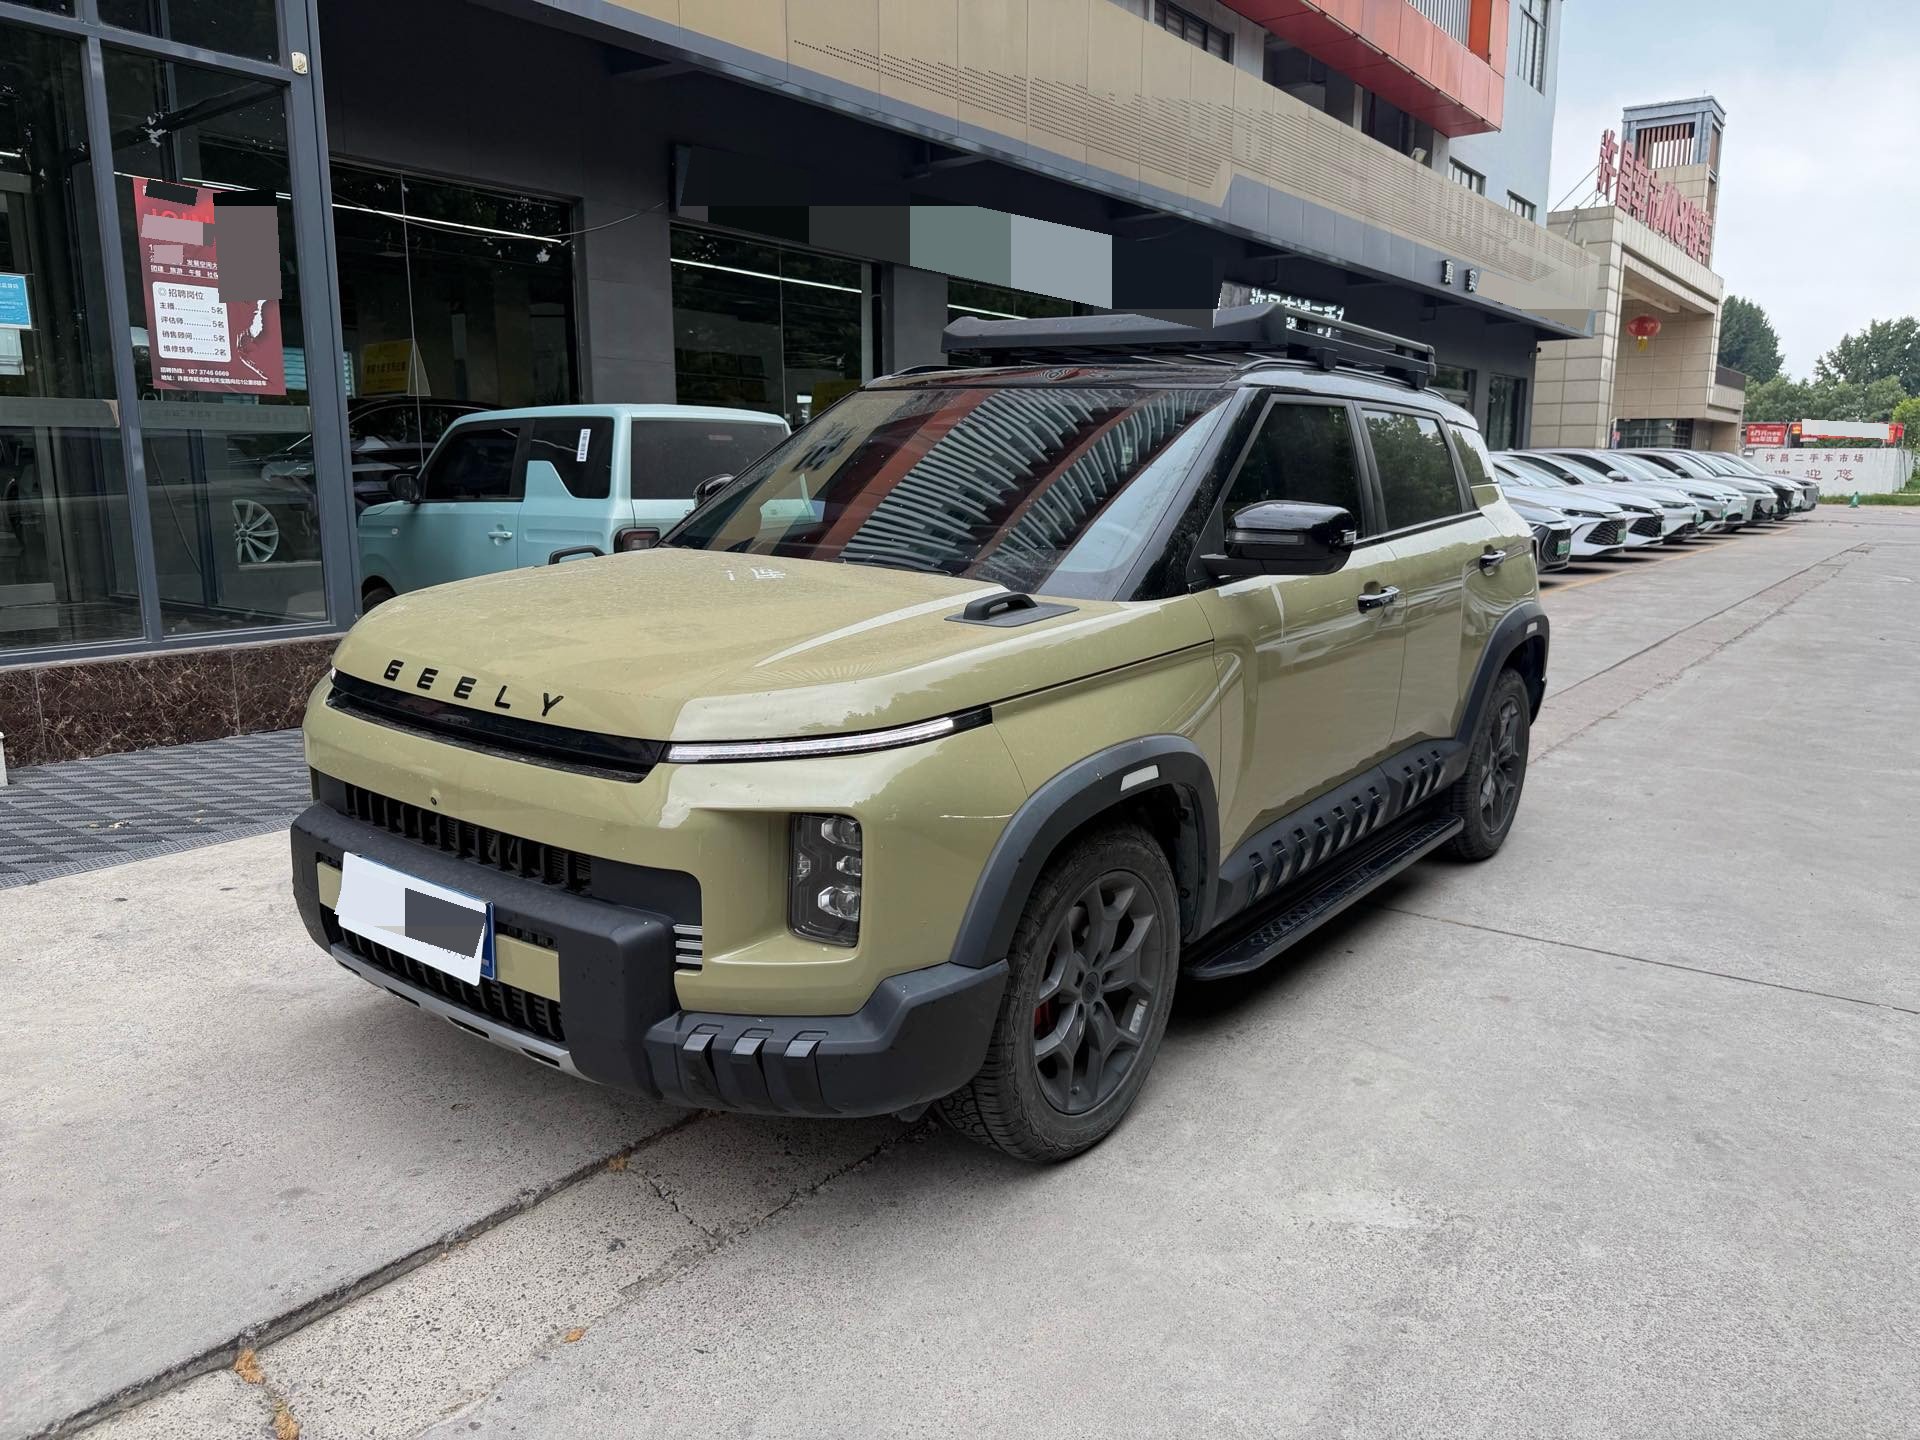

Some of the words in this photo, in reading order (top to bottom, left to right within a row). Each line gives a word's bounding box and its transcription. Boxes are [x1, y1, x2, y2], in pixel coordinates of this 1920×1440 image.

[168, 288, 205, 300] 招聘岗位
[1765, 453, 1864, 464] 许昌二手车市场
[383, 659, 565, 717] GEELY
